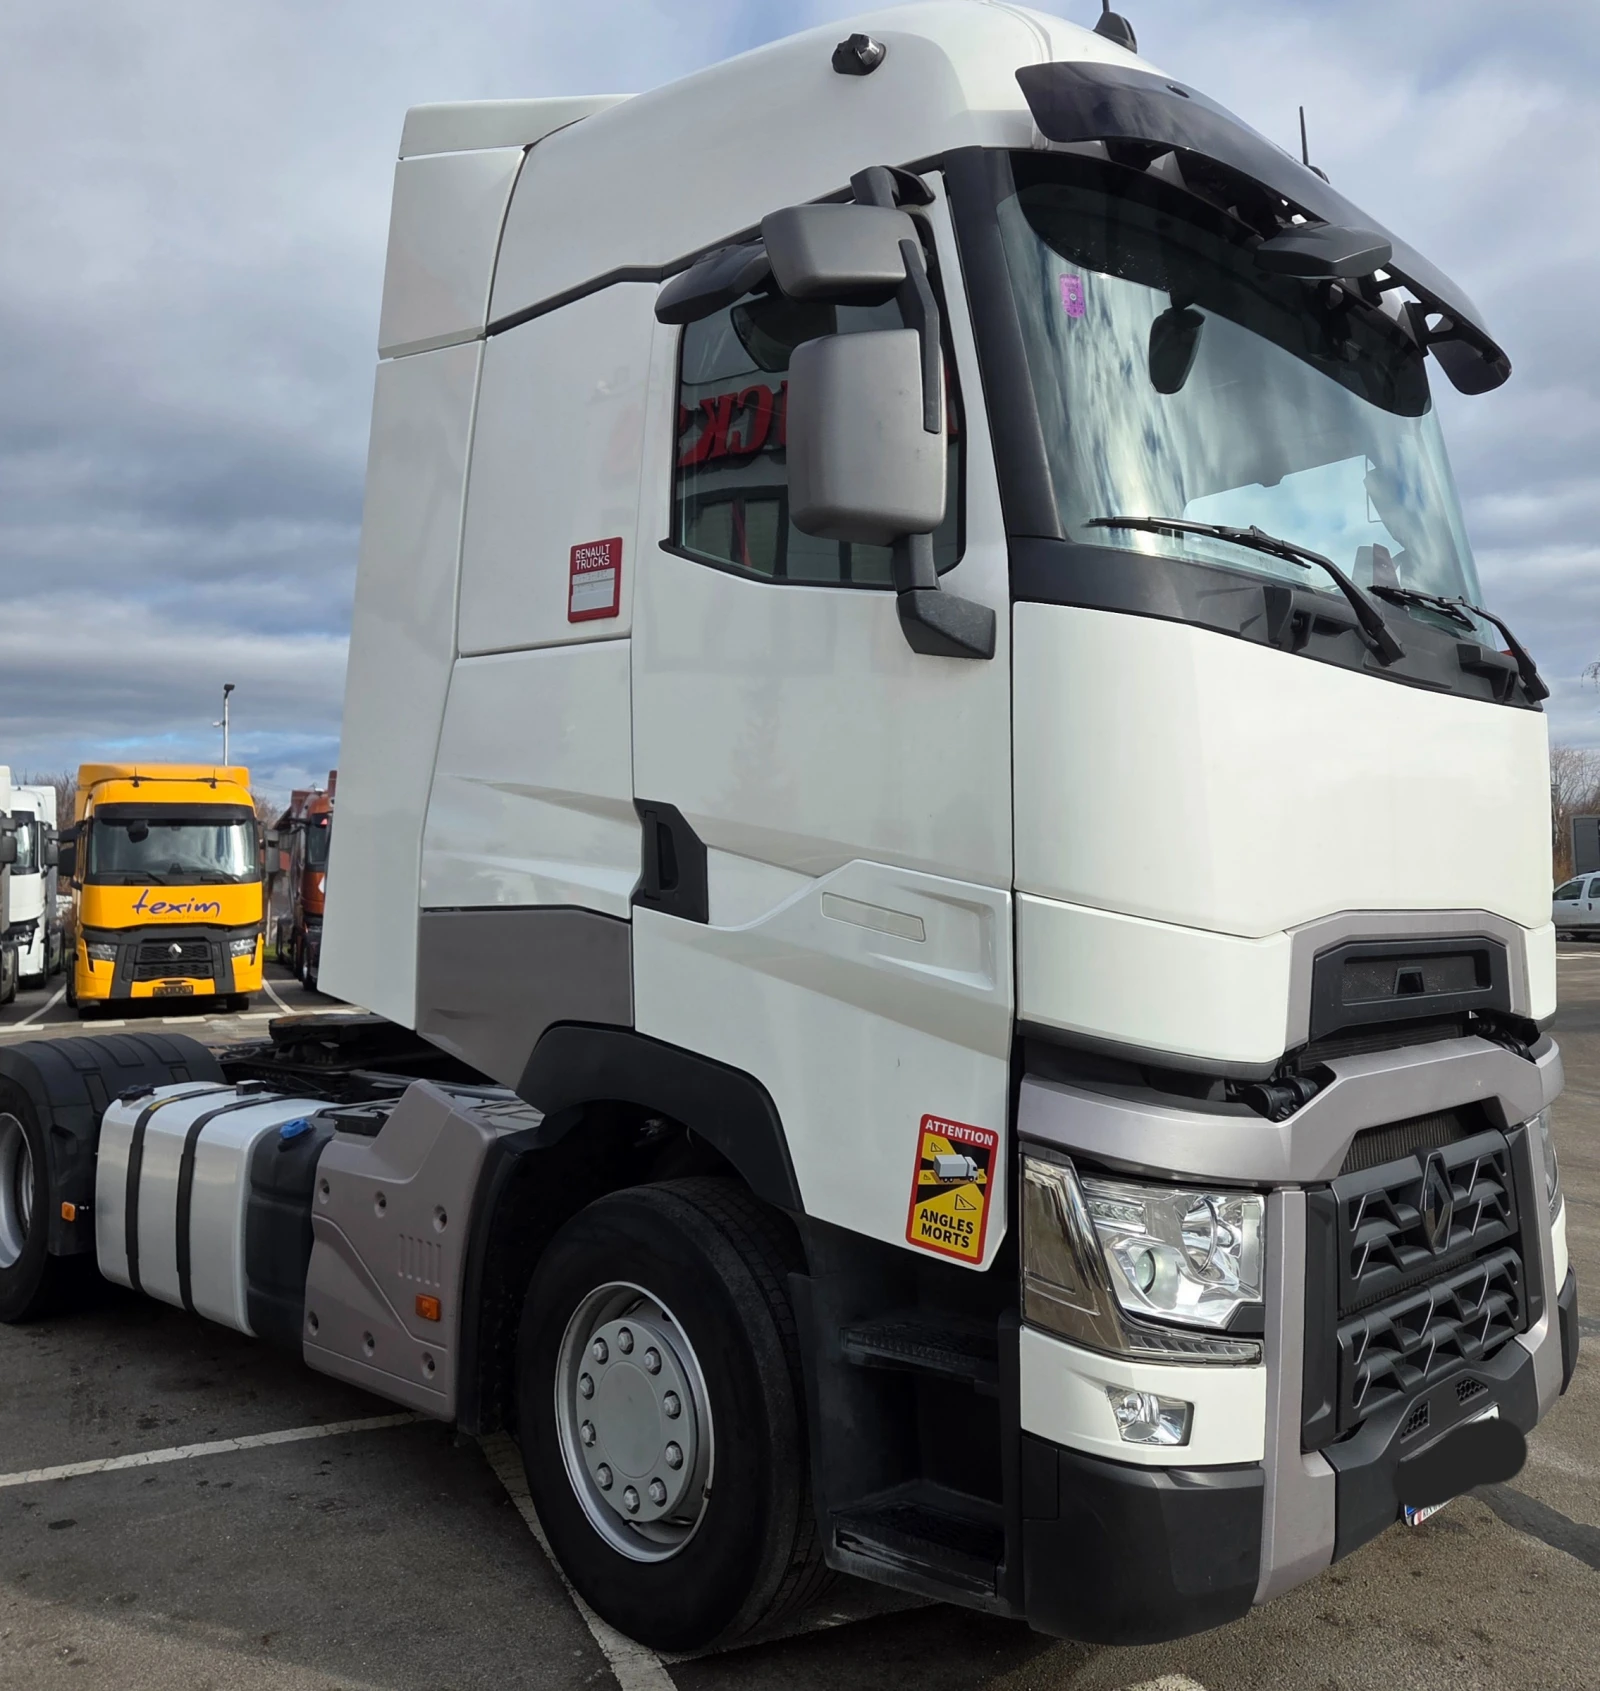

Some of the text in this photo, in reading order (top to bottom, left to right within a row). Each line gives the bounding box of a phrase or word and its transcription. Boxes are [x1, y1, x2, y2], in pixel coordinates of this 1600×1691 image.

[575, 544, 611, 560] RENAULT
[575, 555, 610, 571] TRUCKS
[132, 889, 221, 917] texim
[925, 1119, 994, 1146] ATTENTION
[920, 1208, 974, 1235] ANGLES
[921, 1223, 970, 1249] MORTS
